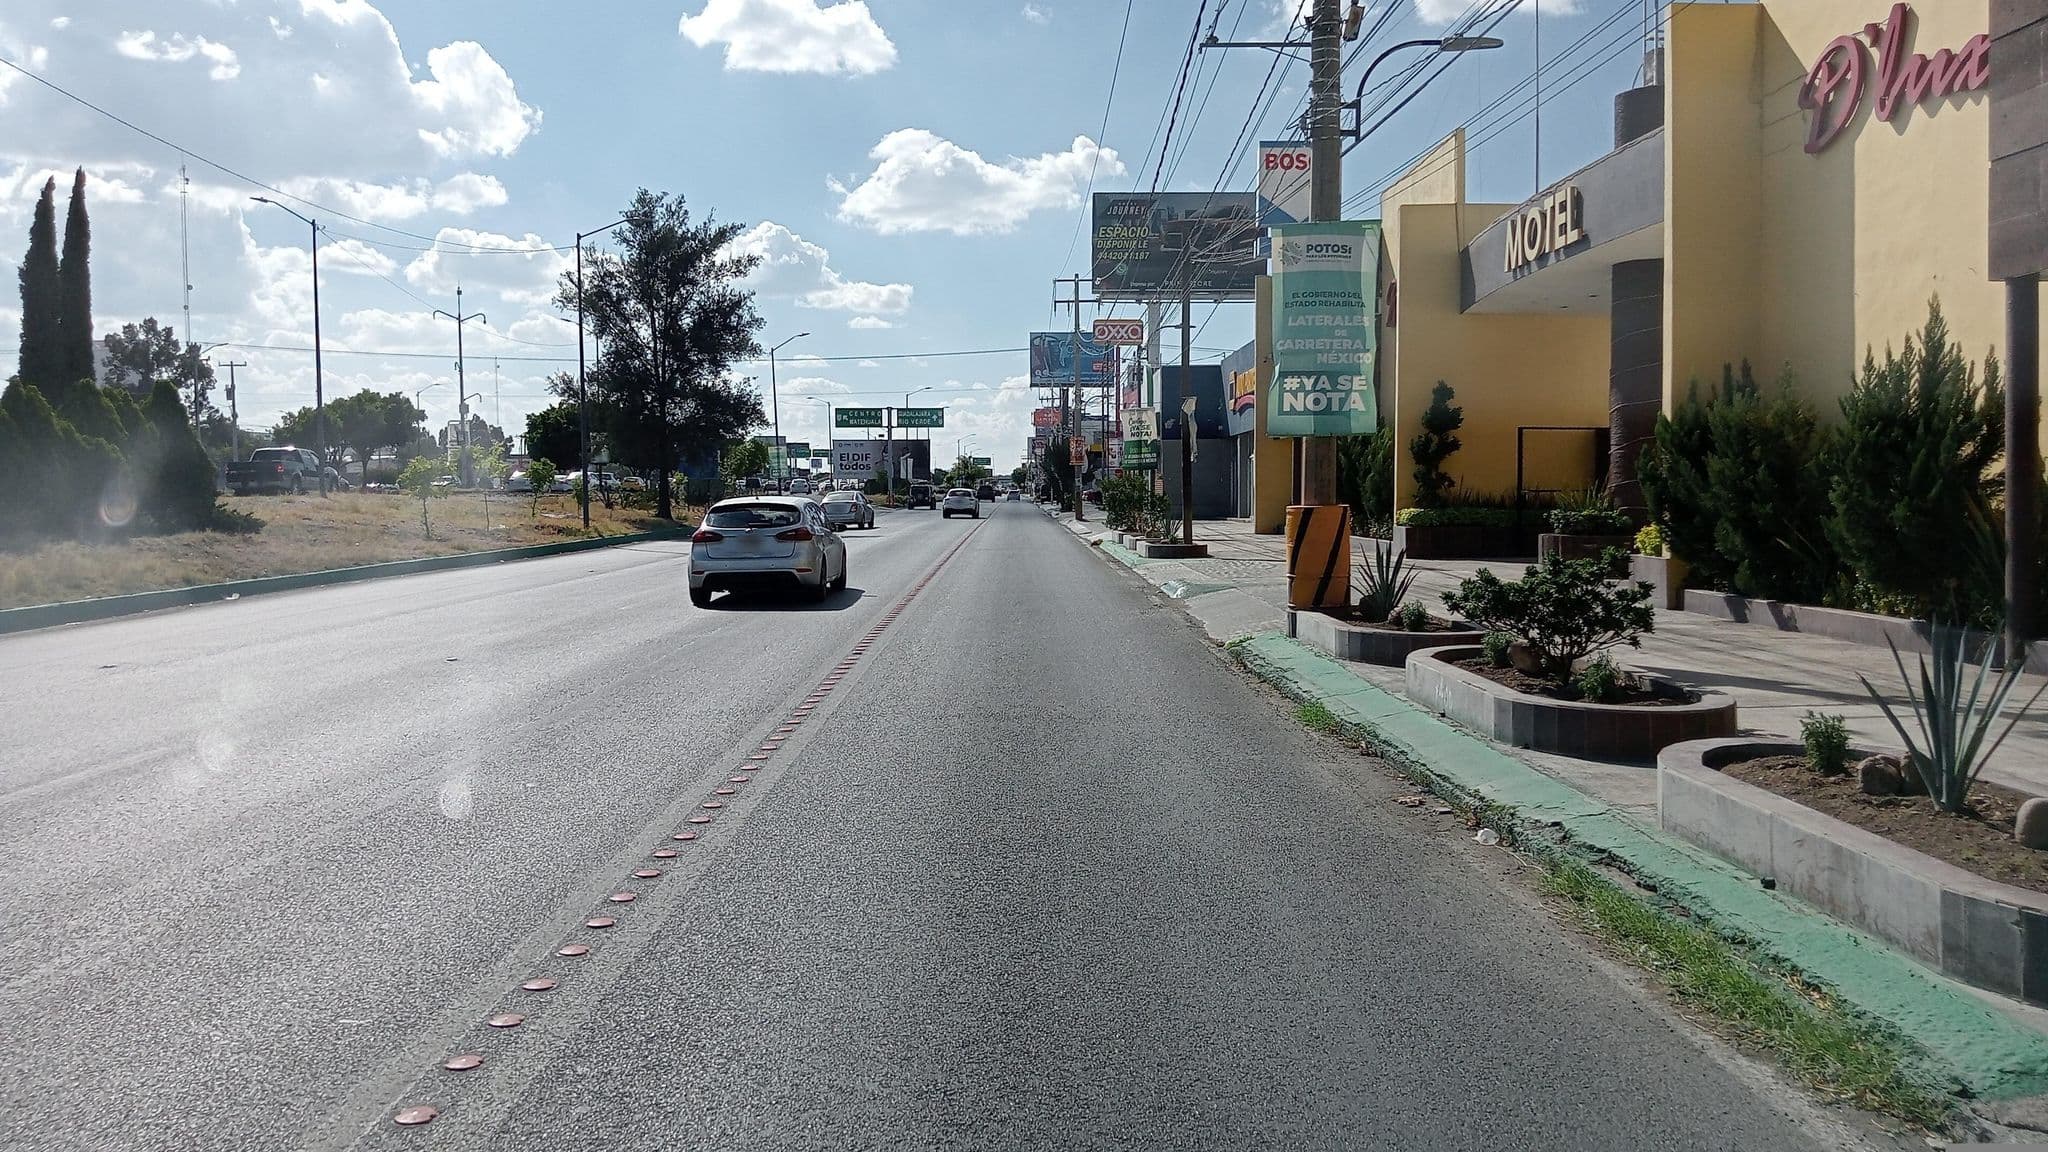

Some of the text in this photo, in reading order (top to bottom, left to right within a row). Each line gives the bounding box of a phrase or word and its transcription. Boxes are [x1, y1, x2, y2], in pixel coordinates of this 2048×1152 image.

[1265, 153, 1311, 171] BOS
[1098, 226, 1149, 238] ESPACIO
[1503, 185, 1584, 274] MOTEL
[1291, 291, 1362, 300] EL GOBIERNO DEL
[1285, 300, 1366, 308] ESTADO REHABILITA
[1287, 315, 1370, 327] LATERALES
[1094, 325, 1142, 340] OXXO
[1276, 338, 1365, 350] CARRETERA
[1316, 350, 1373, 364] MÉXICO
[1283, 375, 1368, 391] #YA SE
[1282, 392, 1366, 412] NOTA
[839, 453, 850, 462] El
[852, 453, 871, 462] DIF
[839, 462, 872, 471] todos
